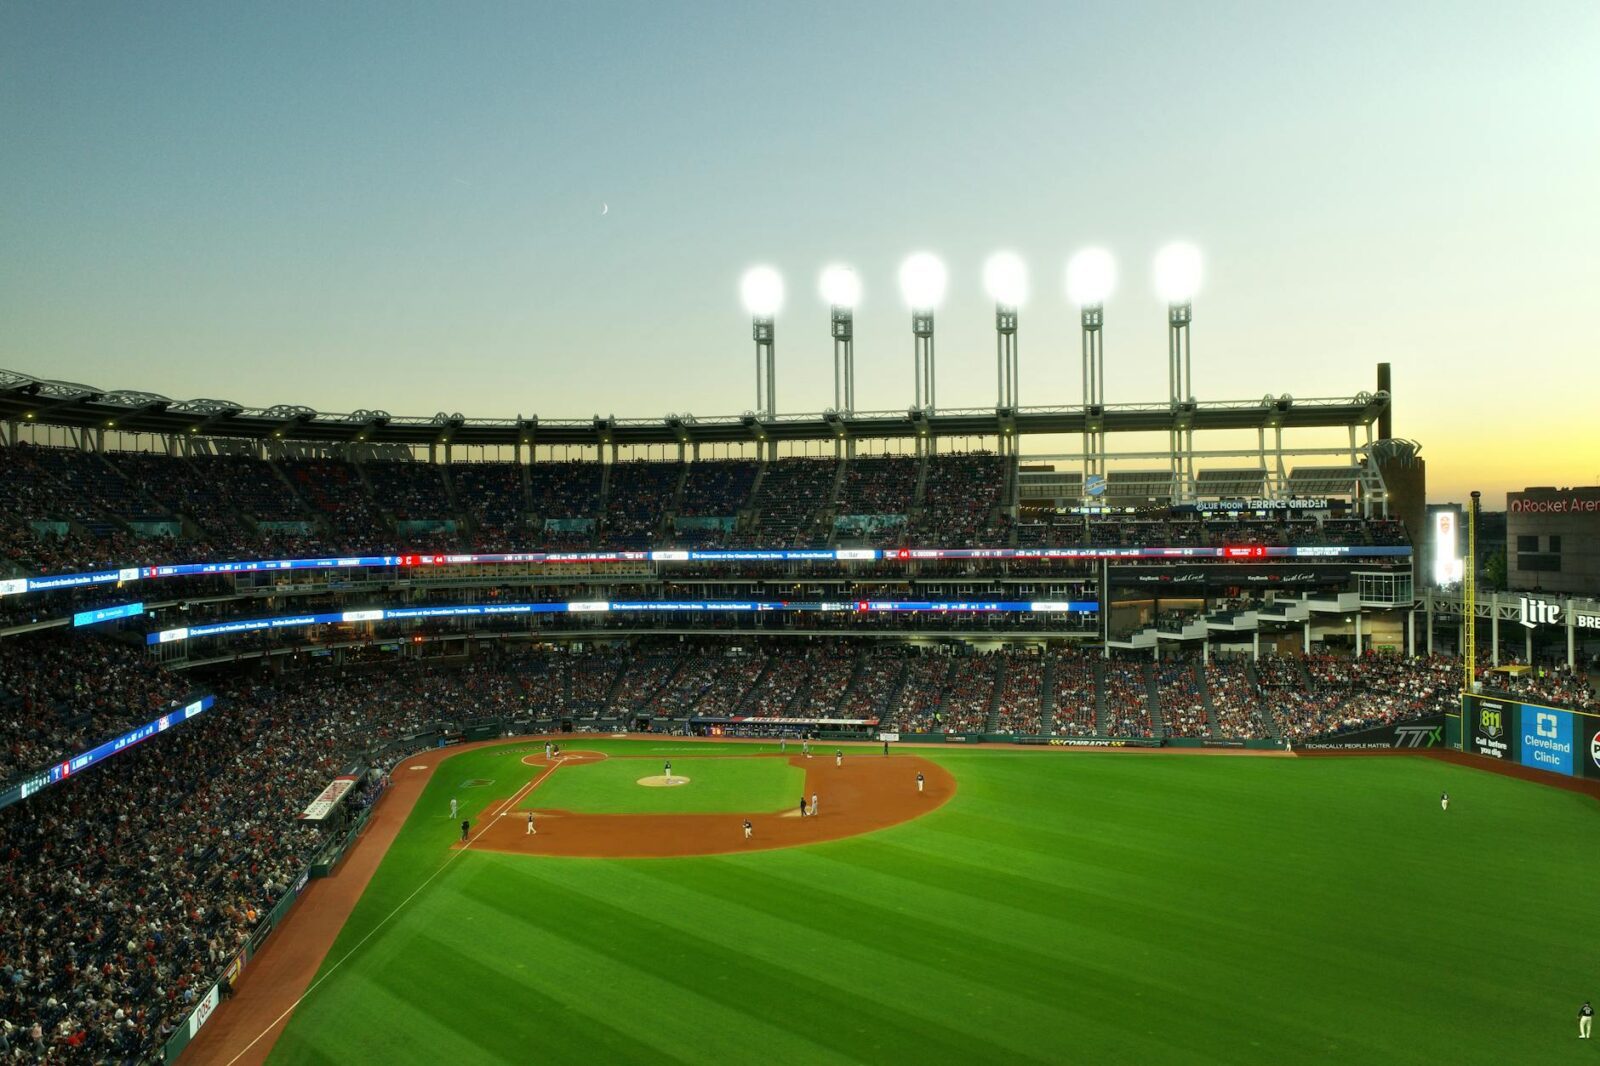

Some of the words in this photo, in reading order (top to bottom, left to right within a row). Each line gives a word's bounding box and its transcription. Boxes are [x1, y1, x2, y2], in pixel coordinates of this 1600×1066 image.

[1246, 500, 1286, 509] TERRACE
[1289, 500, 1328, 508] GARDEN
[1523, 499, 1568, 513] Rocket
[1519, 597, 1560, 629] Lite
[1482, 710, 1500, 729] 811
[1475, 737, 1487, 746] Call
[1488, 739, 1507, 750] before
[1525, 735, 1570, 753] Cleveland
[1480, 747, 1491, 755] you
[1534, 750, 1560, 765] Clinic
